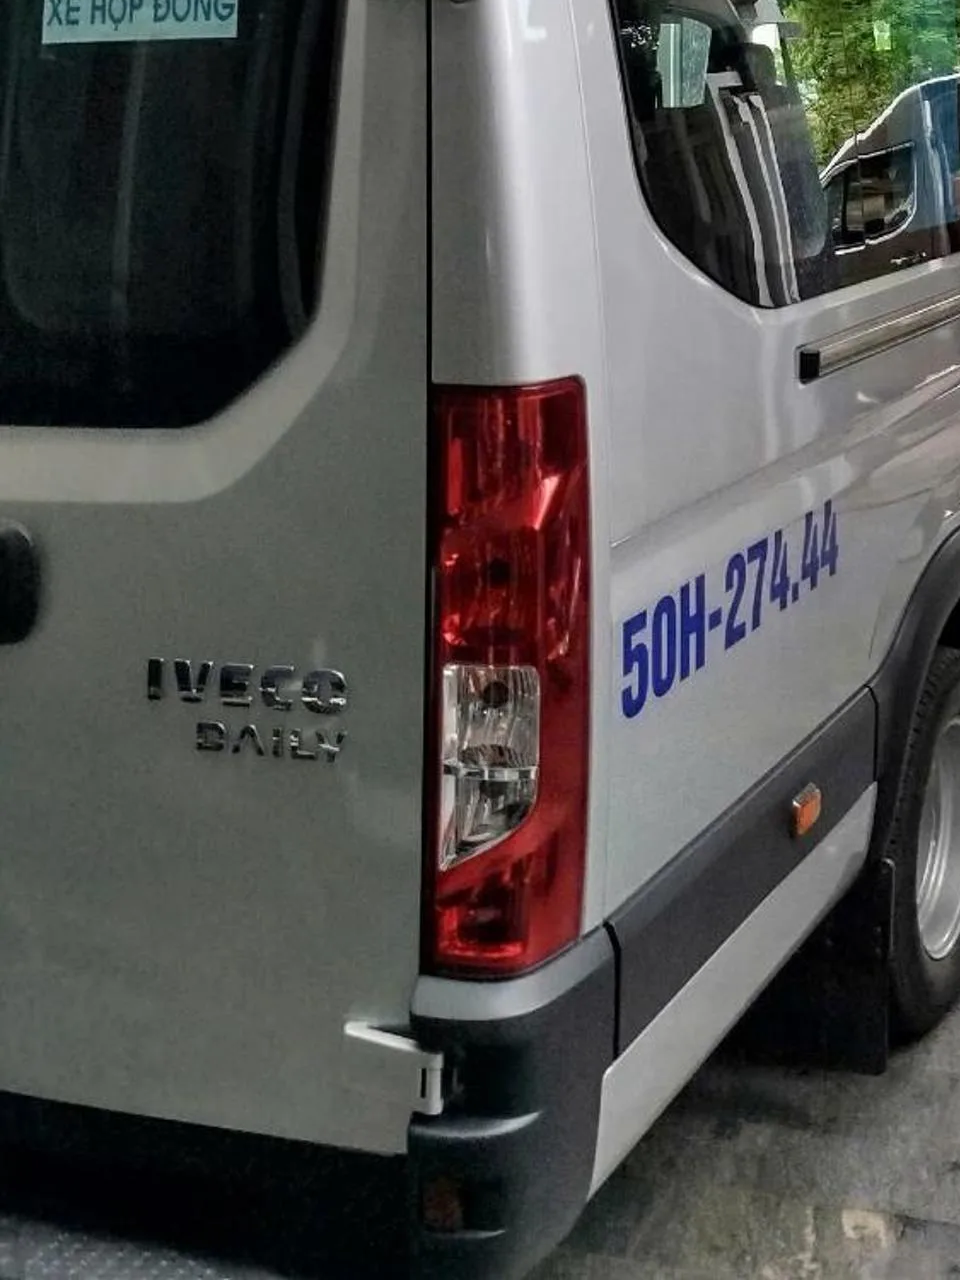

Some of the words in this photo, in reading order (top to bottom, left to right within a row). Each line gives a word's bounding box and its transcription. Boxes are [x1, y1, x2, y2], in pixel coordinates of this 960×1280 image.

[621, 500, 839, 718] 50H-274.44
[147, 657, 348, 714] IVECO
[195, 721, 346, 763] DAILY
